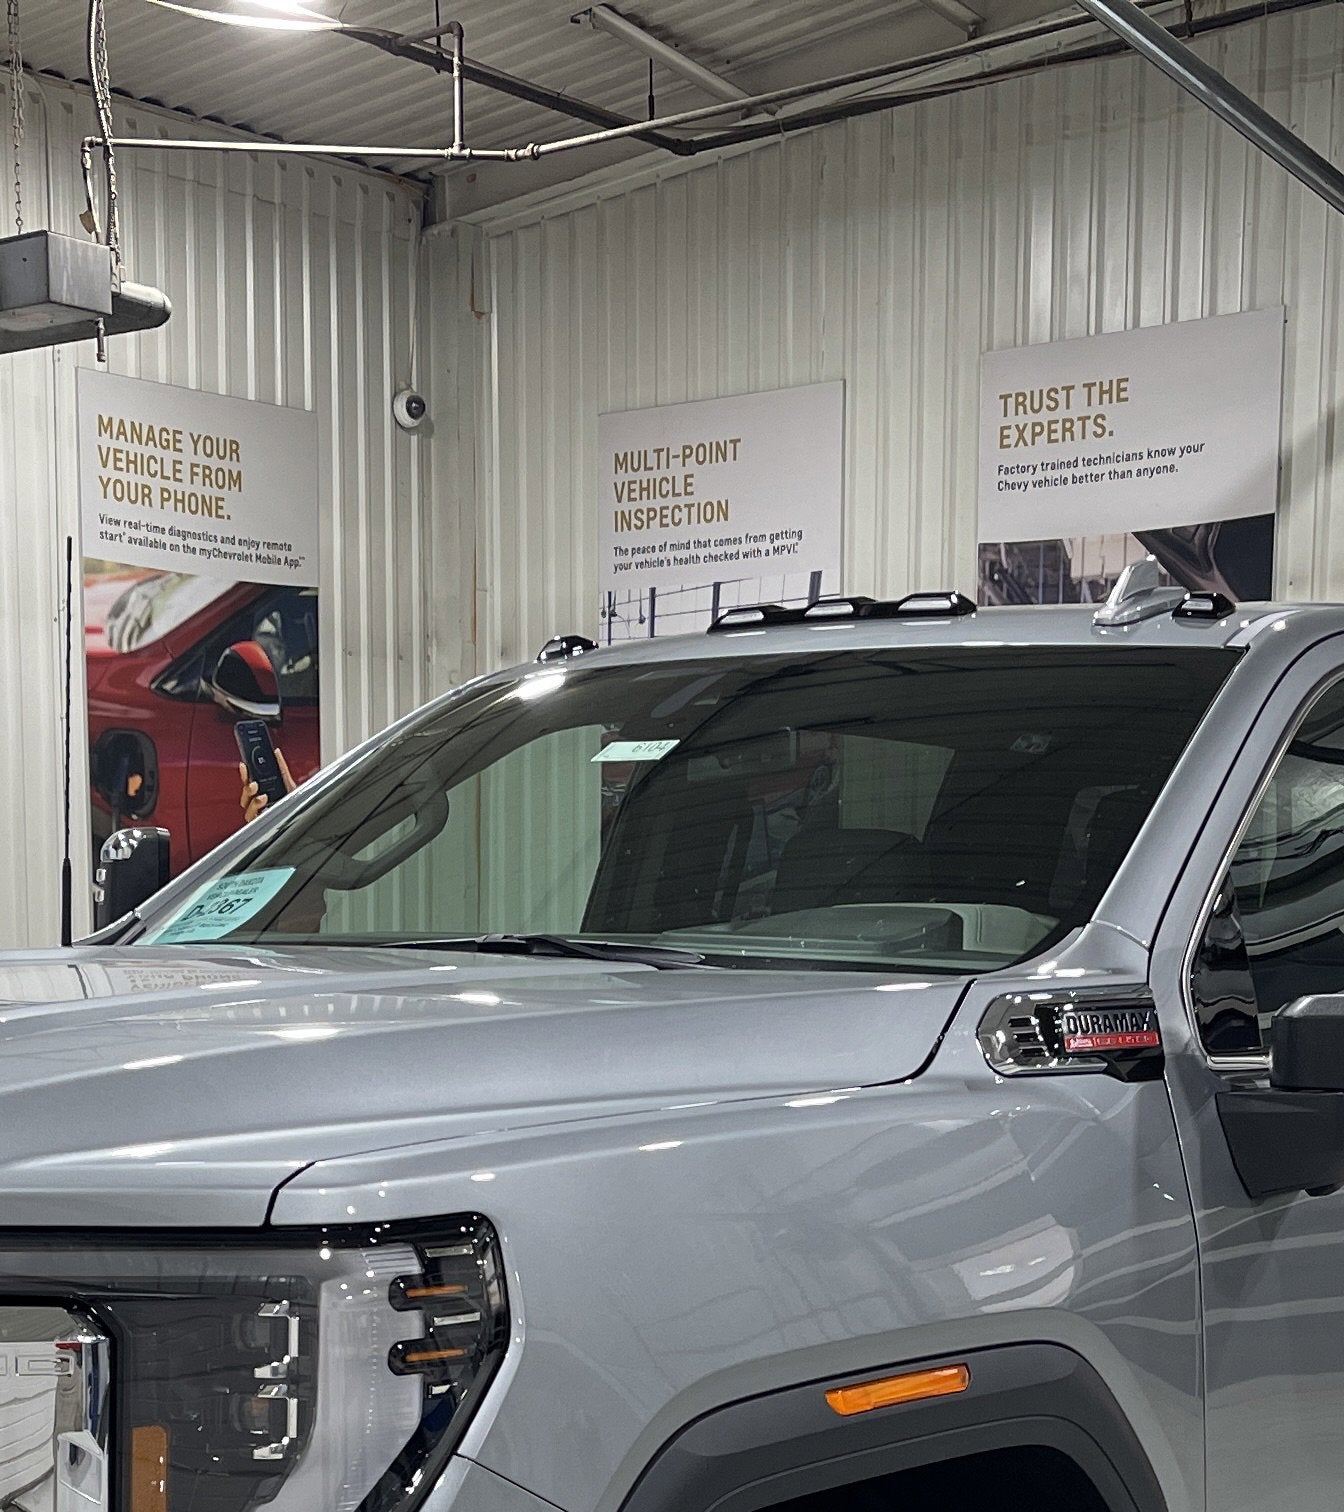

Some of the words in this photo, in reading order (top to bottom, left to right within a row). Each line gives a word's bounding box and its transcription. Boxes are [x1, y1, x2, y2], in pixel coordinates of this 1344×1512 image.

[999, 384, 1076, 418] TRUST
[1082, 377, 1130, 407] THE
[97, 414, 183, 453] MANAGE
[189, 431, 241, 463] YOUR
[999, 413, 1114, 450] EXPERTS.
[97, 444, 183, 483] VEHICLE
[189, 462, 242, 493] FROM
[613, 438, 742, 475] MULTI-POINT
[997, 463, 1038, 478] Factory
[1041, 456, 1079, 471] trained
[1081, 450, 1144, 468] technicians
[1146, 446, 1177, 459] know
[1178, 442, 1206, 458] your
[613, 473, 695, 504] VEHICLE
[997, 479, 1029, 493] Chevy
[1031, 475, 1069, 490] vehicle
[1071, 470, 1106, 486] better
[1108, 468, 1133, 482] than
[1136, 463, 1179, 480] anyone.
[98, 475, 153, 509] YOUR
[160, 487, 231, 520] PHONE.
[98, 513, 121, 527] View
[123, 518, 166, 536] real-time
[168, 525, 218, 544] diagnostics
[220, 533, 236, 547] and
[238, 536, 260, 551] enjoy
[262, 540, 292, 553] remote
[613, 499, 729, 533] INSPECTION
[127, 534, 167, 551] available
[169, 541, 180, 552] on
[183, 542, 197, 556] the
[199, 546, 253, 564] myChevrolet
[255, 552, 282, 567] Mobile
[613, 545, 629, 557] The
[631, 543, 656, 559] peace
[658, 541, 668, 553] of
[669, 539, 691, 552] mind
[693, 537, 712, 550] that
[714, 534, 742, 548] comes
[745, 531, 767, 544] from
[769, 528, 803, 544] getting
[613, 559, 632, 575] your
[634, 555, 671, 570] vehicle's
[673, 554, 701, 566] health
[703, 550, 740, 564] checked
[742, 548, 762, 560] with
[1063, 1011, 1151, 1035] DURAMAX
